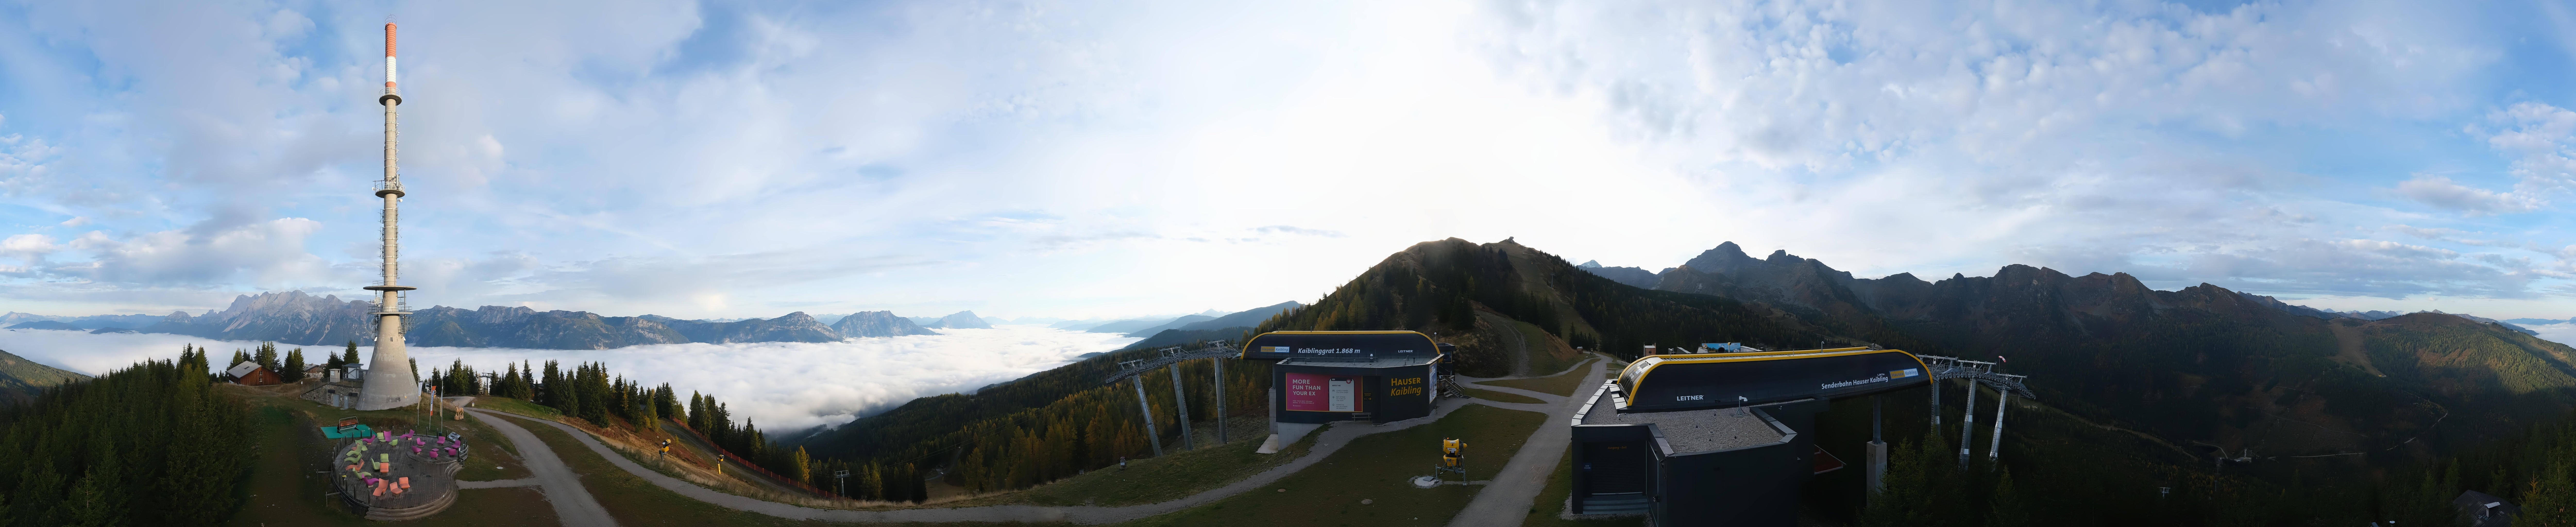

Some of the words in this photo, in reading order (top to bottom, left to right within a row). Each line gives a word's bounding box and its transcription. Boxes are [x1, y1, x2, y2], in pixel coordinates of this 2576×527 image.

[1391, 378, 1421, 386] HAUSER
[1821, 381, 1852, 389] Senderbahn
[1391, 386, 1421, 396] Kaibling
